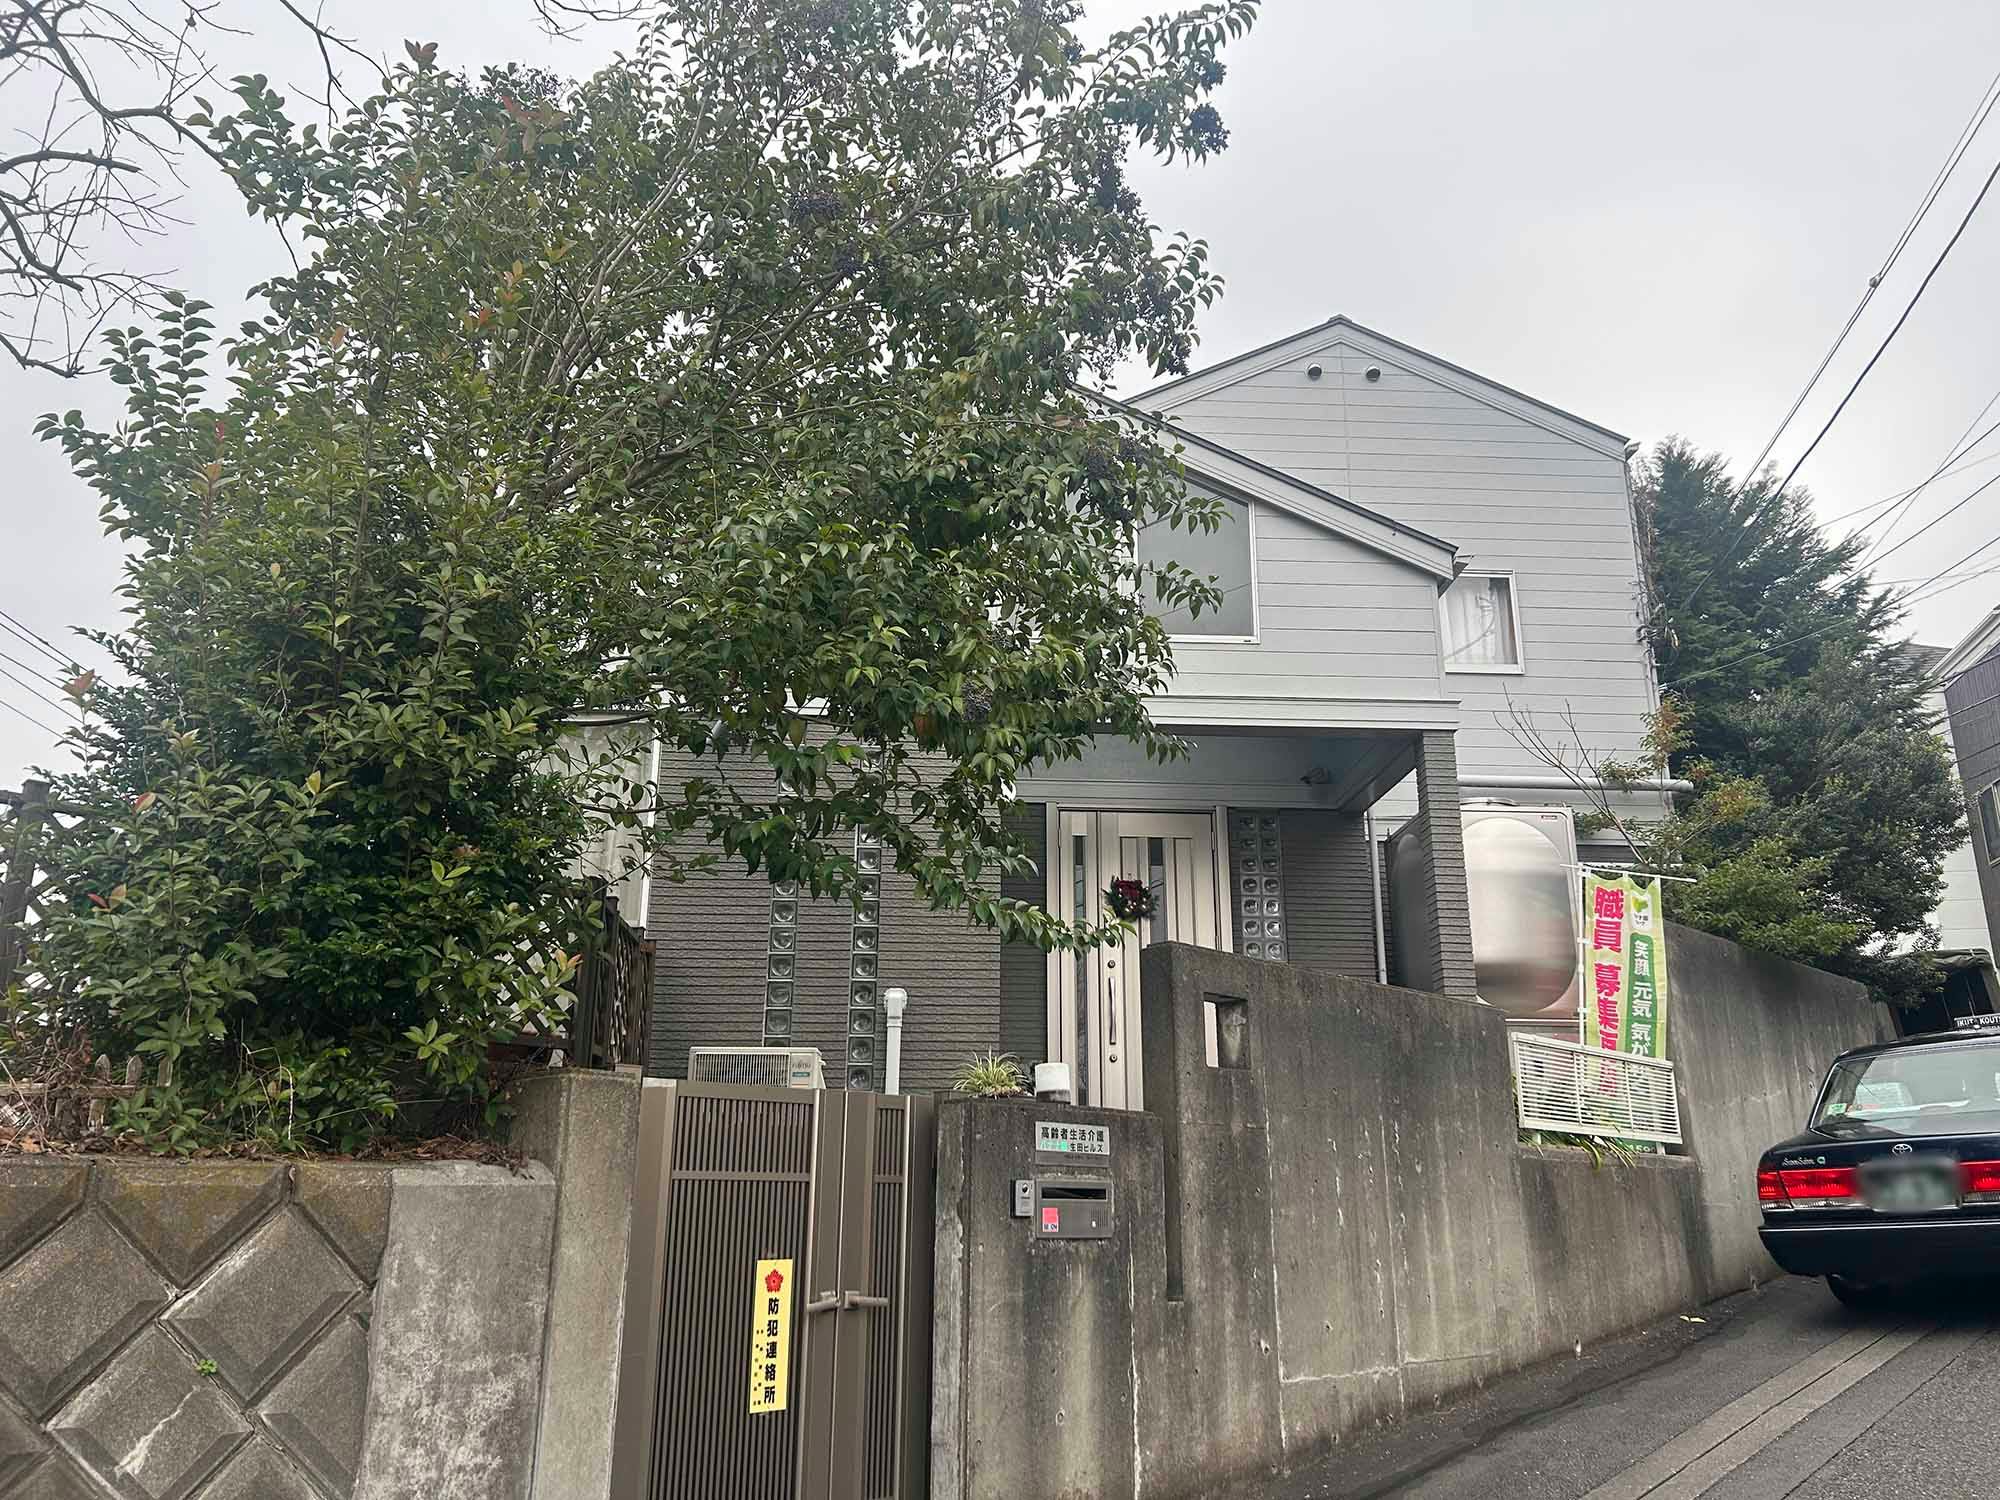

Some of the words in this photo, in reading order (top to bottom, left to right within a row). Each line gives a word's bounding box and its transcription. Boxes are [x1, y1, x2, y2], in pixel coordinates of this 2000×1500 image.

[1634, 941, 1651, 977] 笑顔
[1632, 981, 1652, 1019] 元気
[763, 1297, 780, 1405] 防犯連絡所
